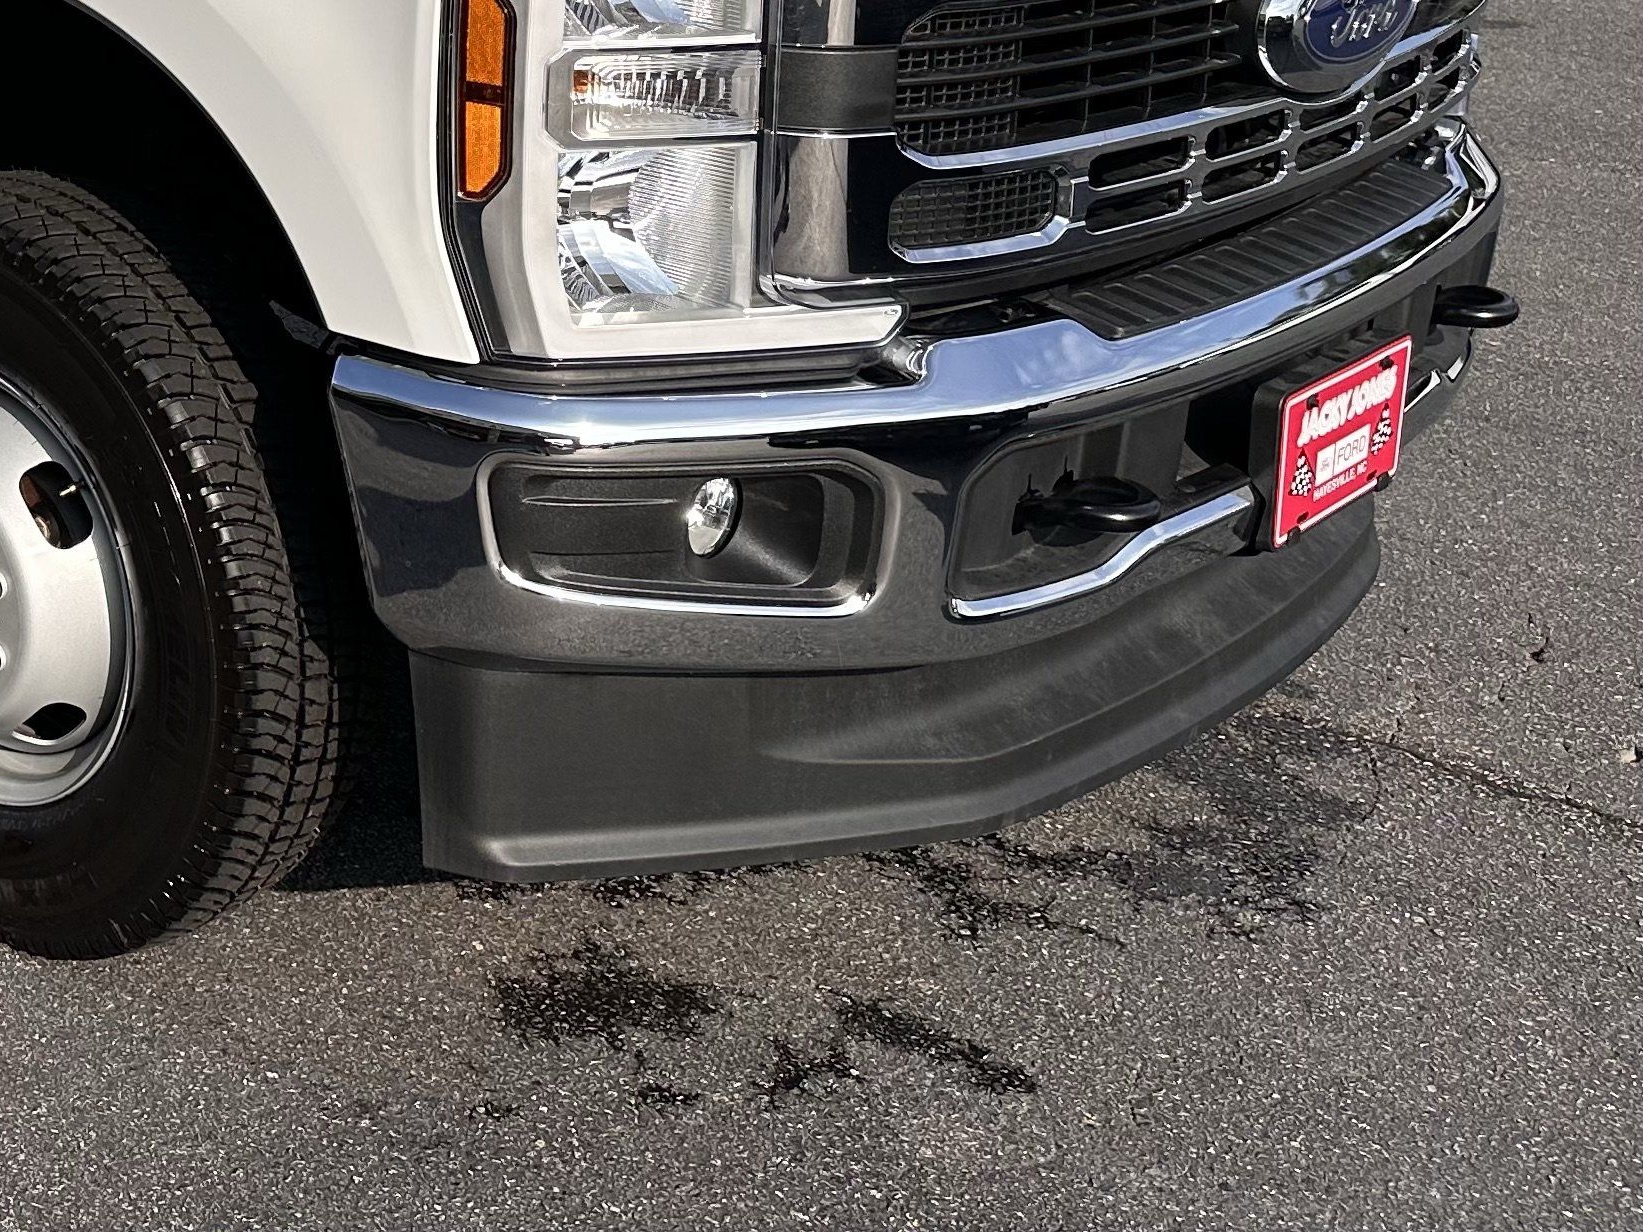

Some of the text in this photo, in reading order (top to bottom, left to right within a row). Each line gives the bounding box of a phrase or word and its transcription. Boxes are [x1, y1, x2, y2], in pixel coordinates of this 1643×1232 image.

[1296, 365, 1399, 448] JACKY JONES
[1336, 434, 1368, 466] FORD
